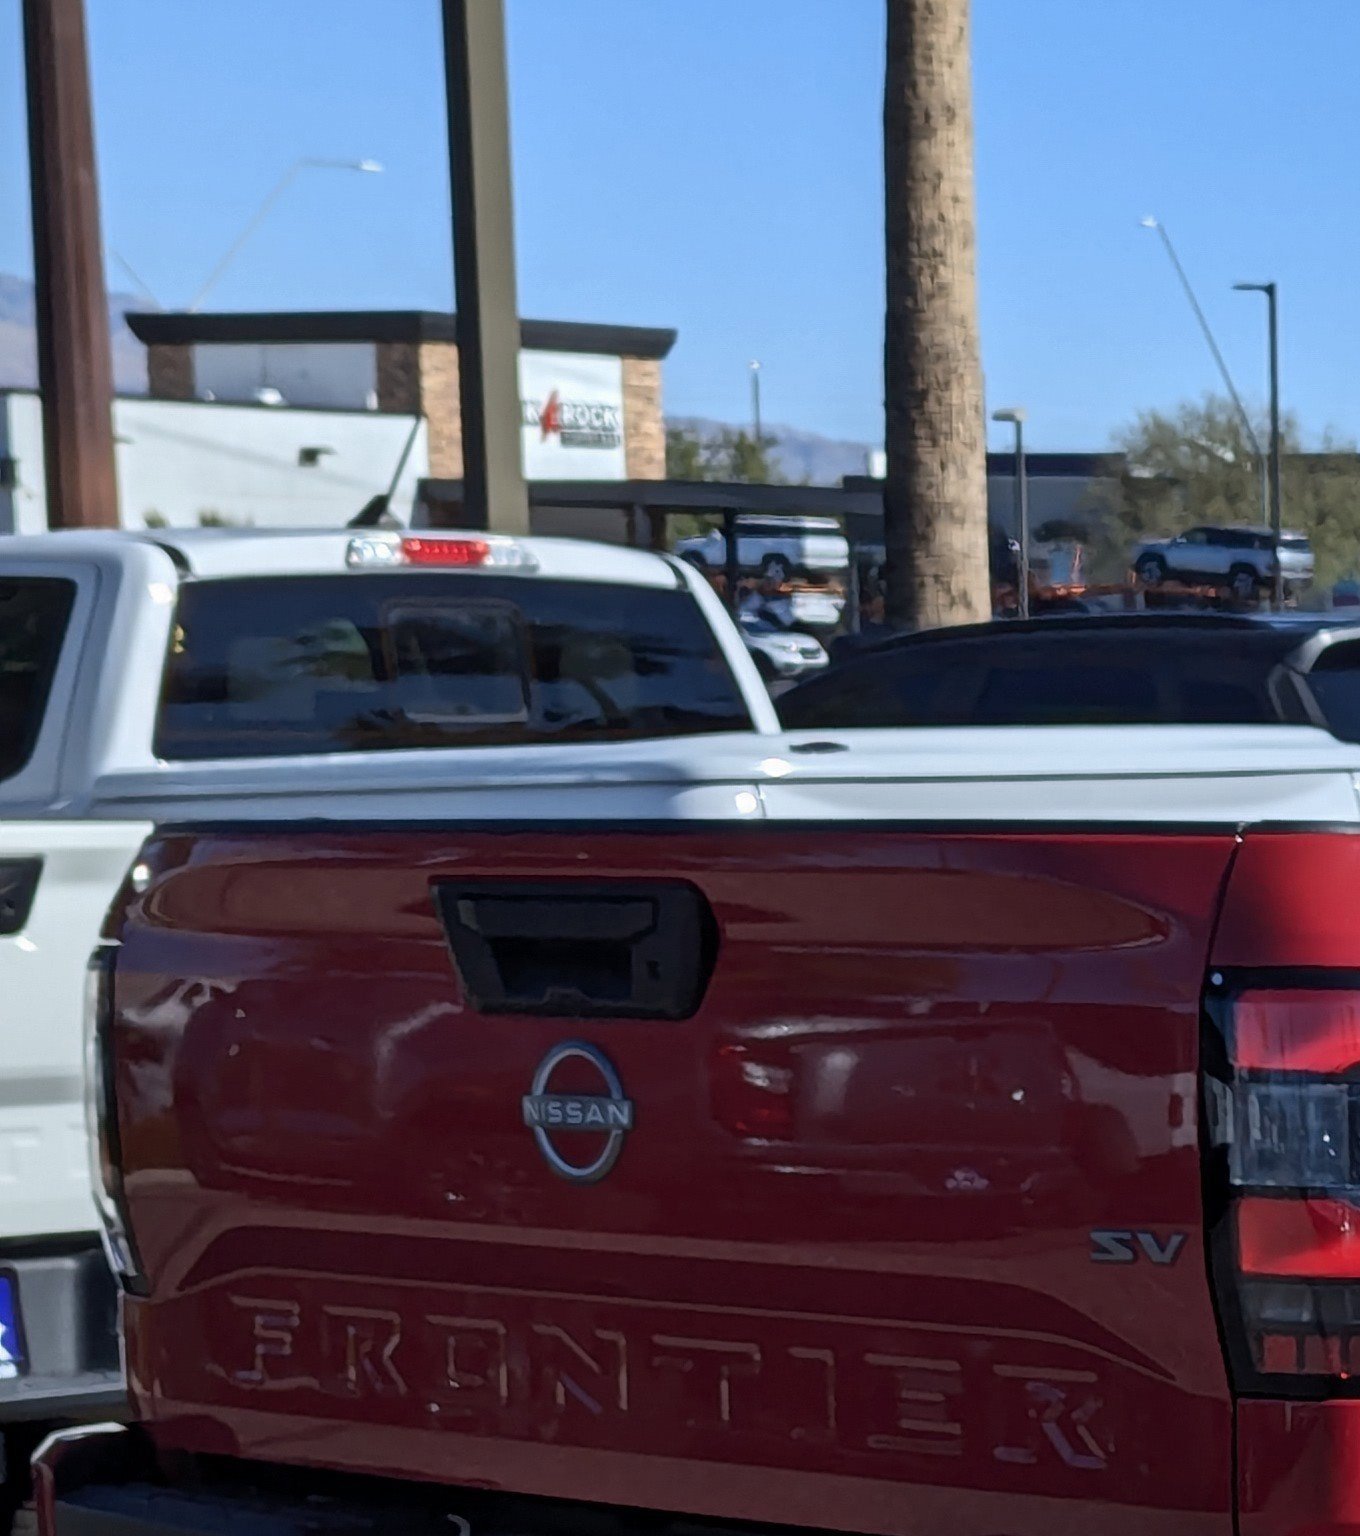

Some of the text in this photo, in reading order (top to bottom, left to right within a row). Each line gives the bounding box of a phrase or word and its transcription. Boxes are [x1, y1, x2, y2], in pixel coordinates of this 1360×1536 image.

[523, 1100, 632, 1126] NISSAN
[1088, 1229, 1190, 1266] SV
[222, 1294, 1115, 1470] FRONTIER
